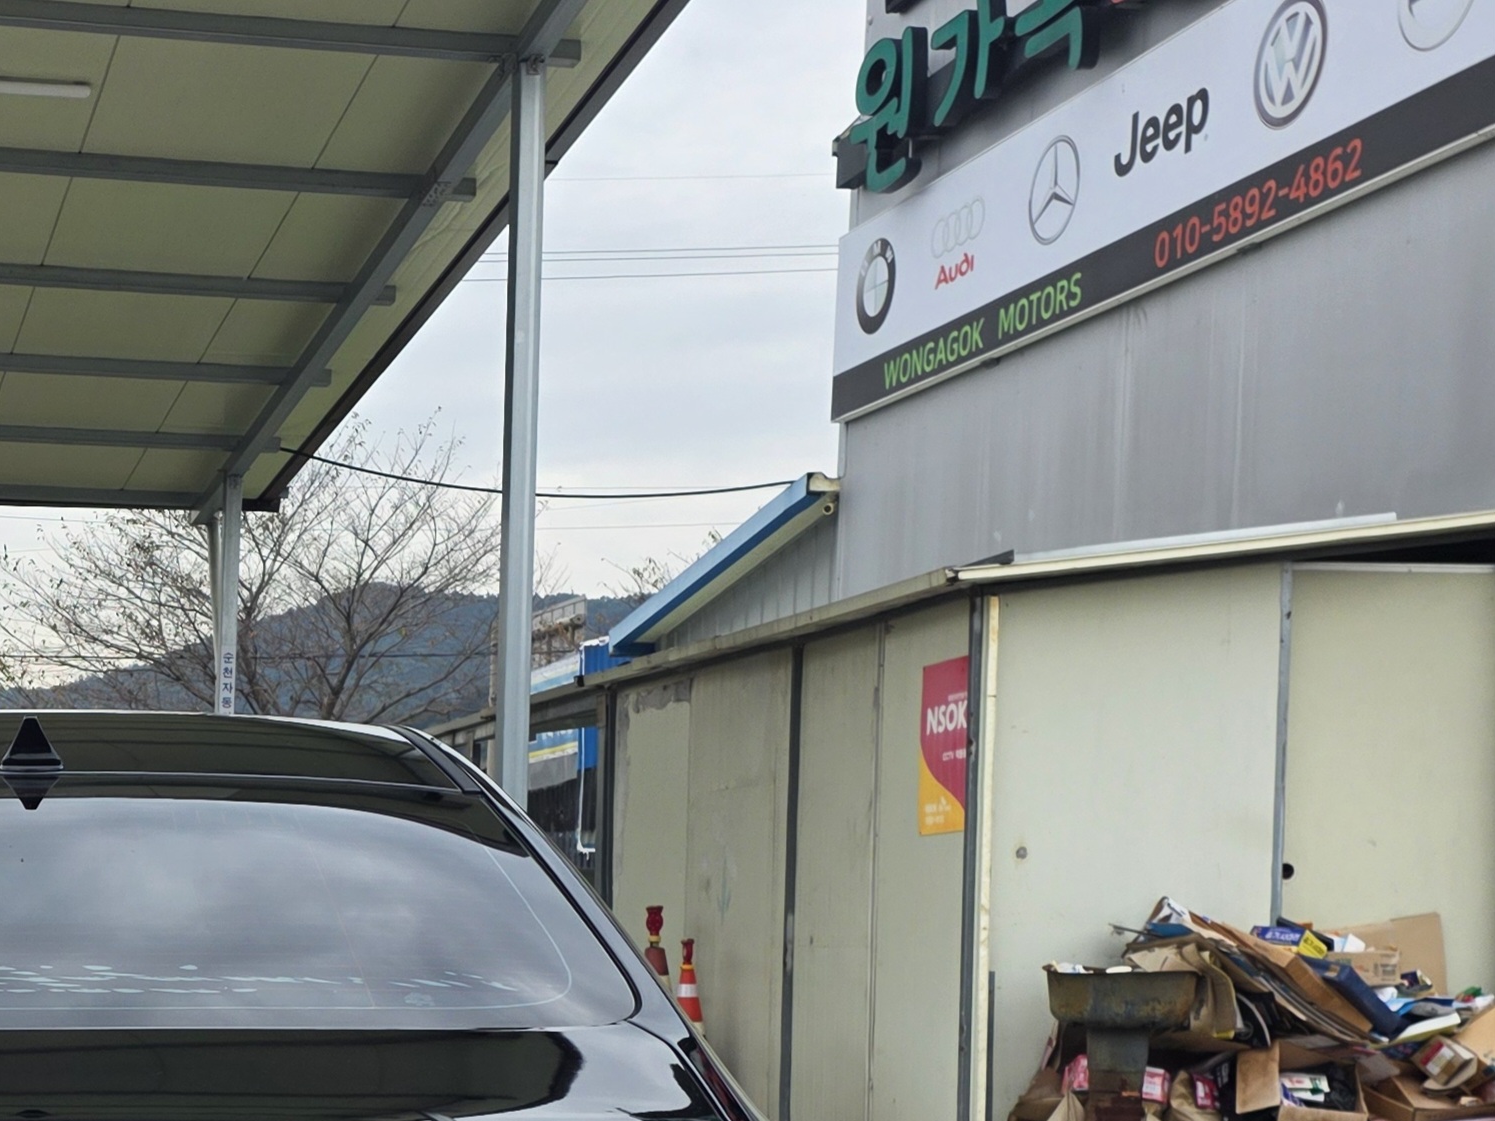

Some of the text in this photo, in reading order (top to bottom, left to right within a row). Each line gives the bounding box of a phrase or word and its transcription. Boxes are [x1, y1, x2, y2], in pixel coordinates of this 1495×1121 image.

[1114, 87, 1210, 178] Jeep
[1154, 138, 1363, 268] 010-5892-4862
[934, 252, 975, 290] Audi
[883, 272, 1082, 390] WONGAGOK MOTORS
[222, 652, 234, 714] 순천자동
[926, 700, 967, 736] NSOK
